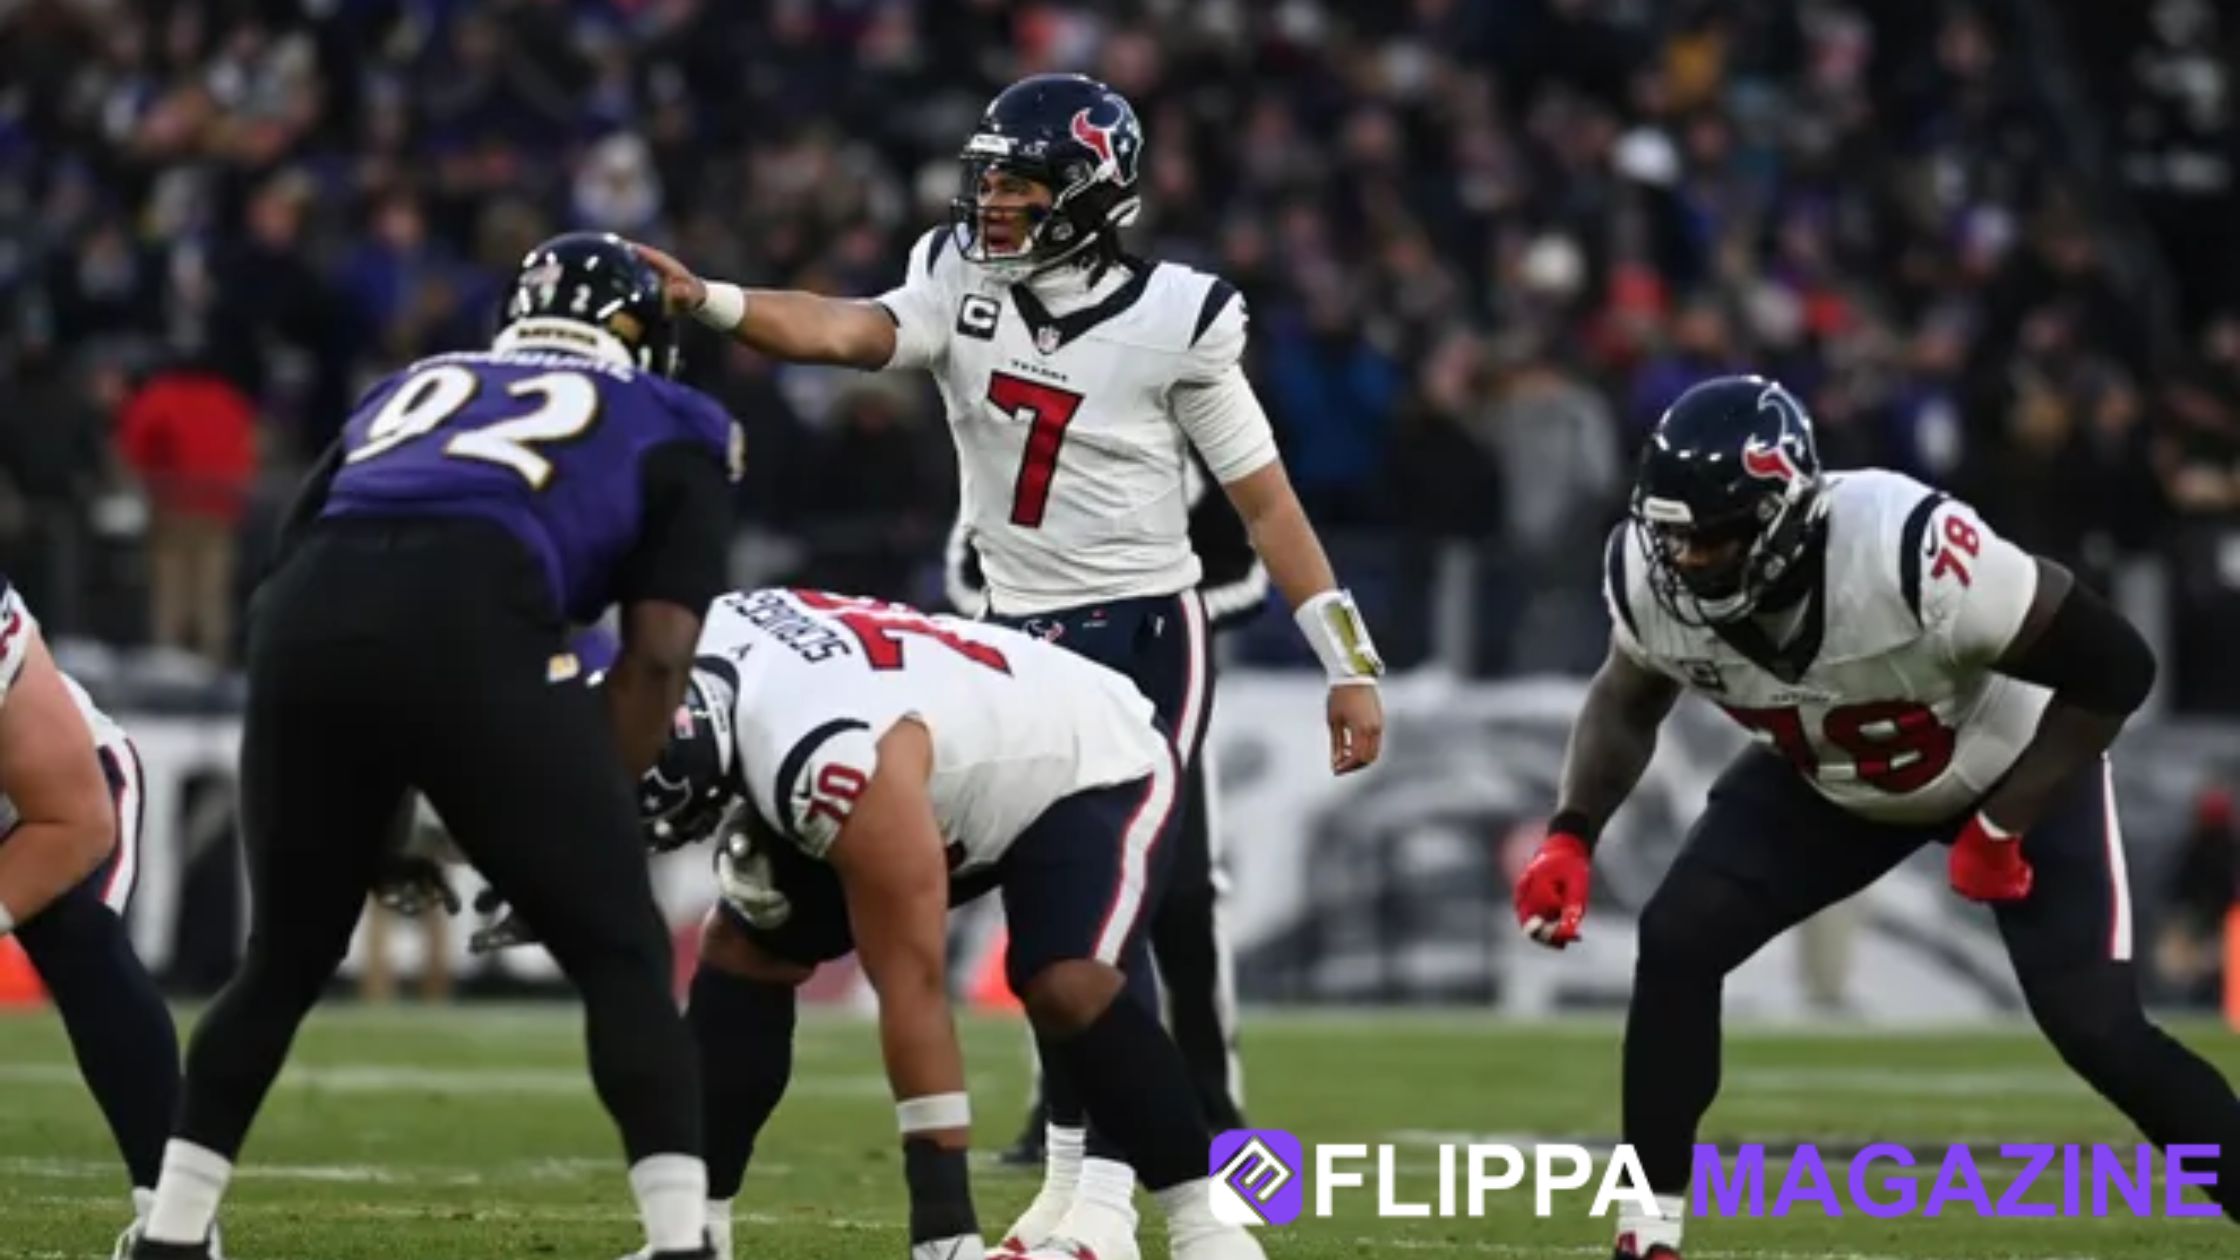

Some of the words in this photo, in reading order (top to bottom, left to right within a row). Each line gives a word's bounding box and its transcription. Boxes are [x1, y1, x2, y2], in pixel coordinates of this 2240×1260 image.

[963, 300, 995, 329] C
[345, 364, 600, 490] 92
[986, 369, 1085, 529] 7
[1931, 515, 1982, 588] 78
[1724, 700, 1955, 793] 78
[804, 762, 867, 823] 70
